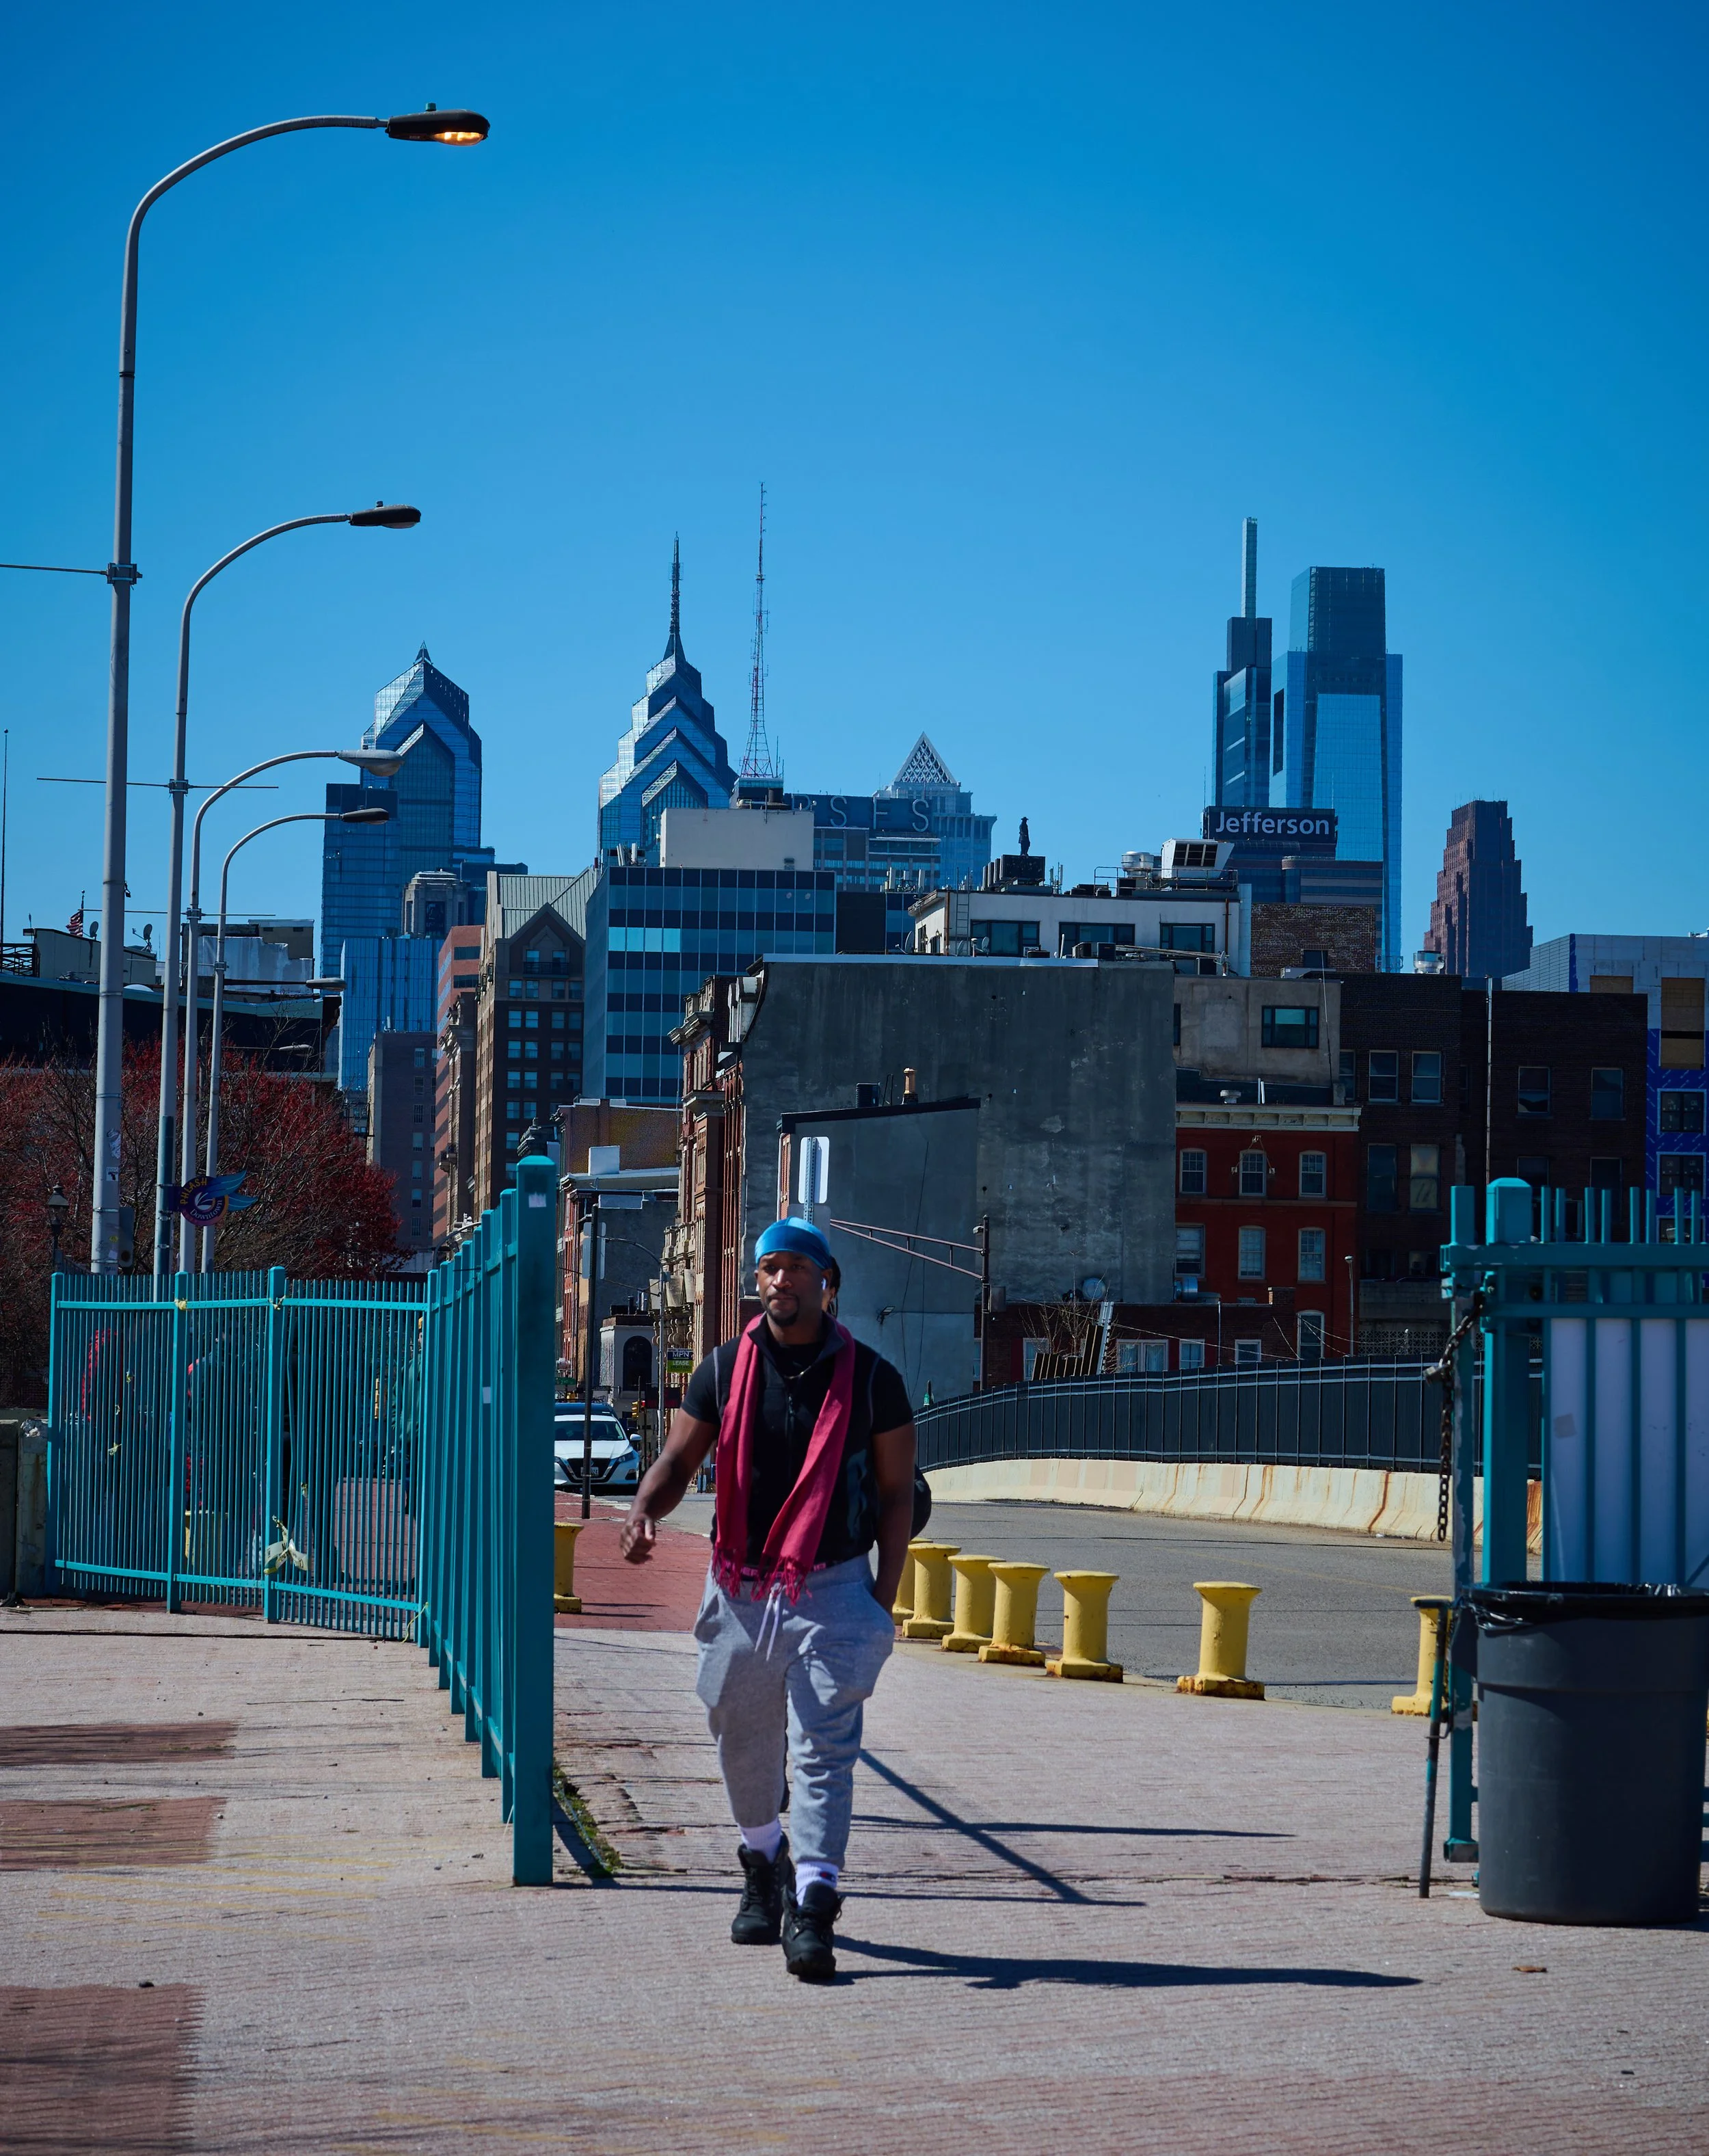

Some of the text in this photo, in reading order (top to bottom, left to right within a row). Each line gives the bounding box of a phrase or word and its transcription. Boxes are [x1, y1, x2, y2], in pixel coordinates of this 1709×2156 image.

[1215, 812, 1329, 835] Jefferson
[180, 1177, 207, 1205] PHLASH
[189, 1200, 223, 1220] Downtown
